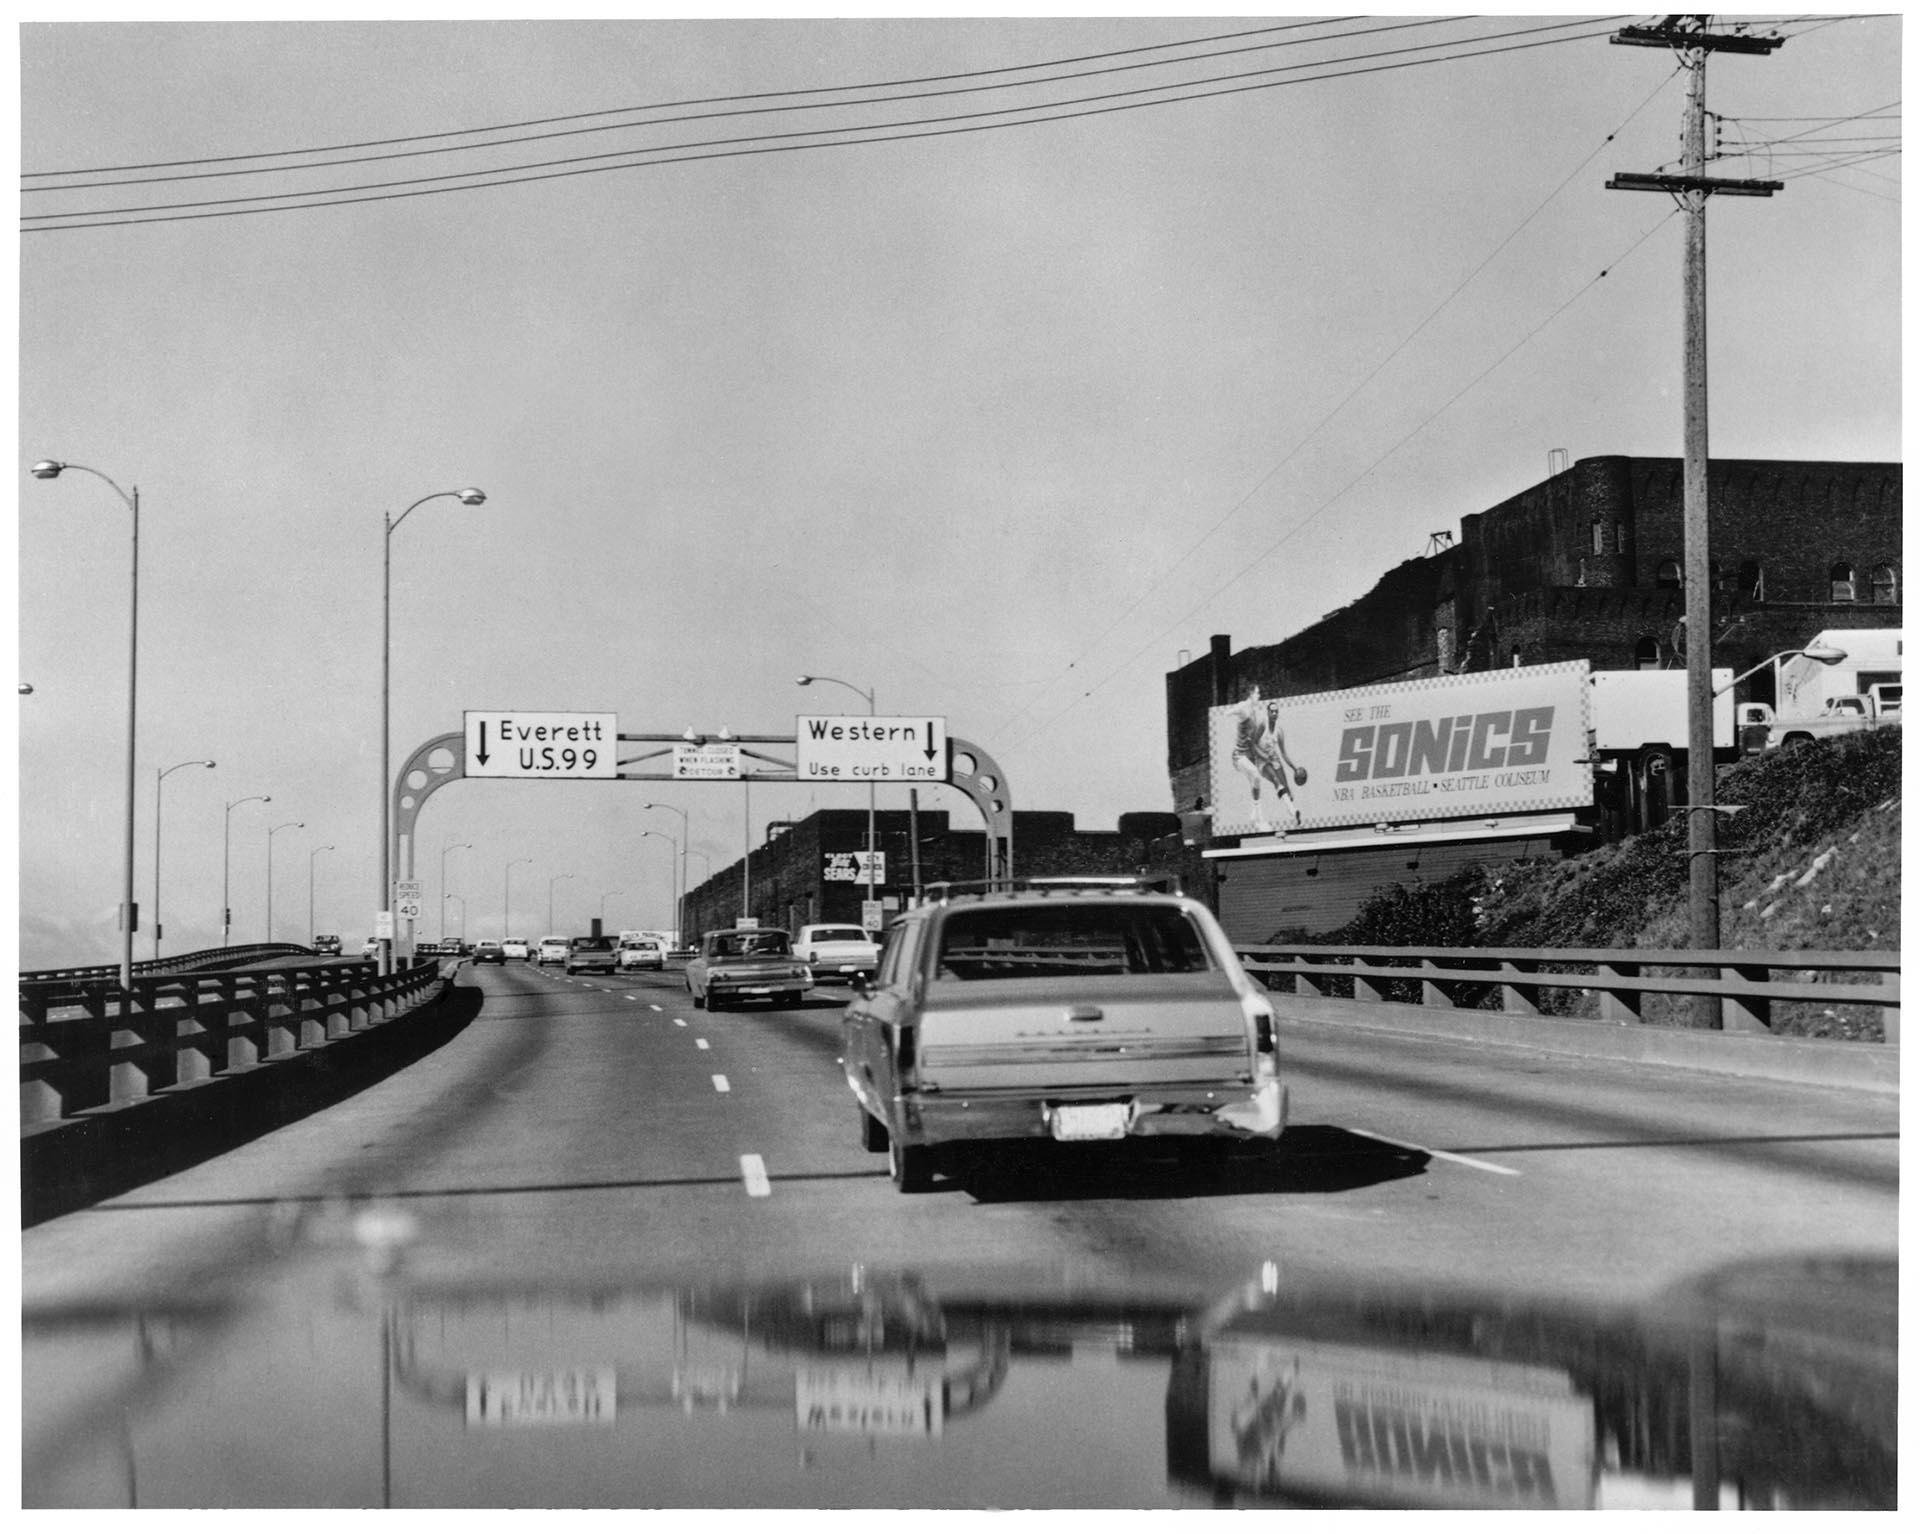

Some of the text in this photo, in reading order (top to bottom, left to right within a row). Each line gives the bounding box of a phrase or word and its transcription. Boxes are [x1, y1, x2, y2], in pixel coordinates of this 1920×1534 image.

[1344, 704, 1391, 722] SEE THE
[500, 720, 602, 741] Everett
[808, 720, 915, 740] Western
[809, 761, 936, 776] Use curb lane
[1333, 769, 1551, 801] NBA BASKETBALL SEATTLE COLISEUM
[400, 905, 418, 917] 40
[866, 920, 880, 929] 40
